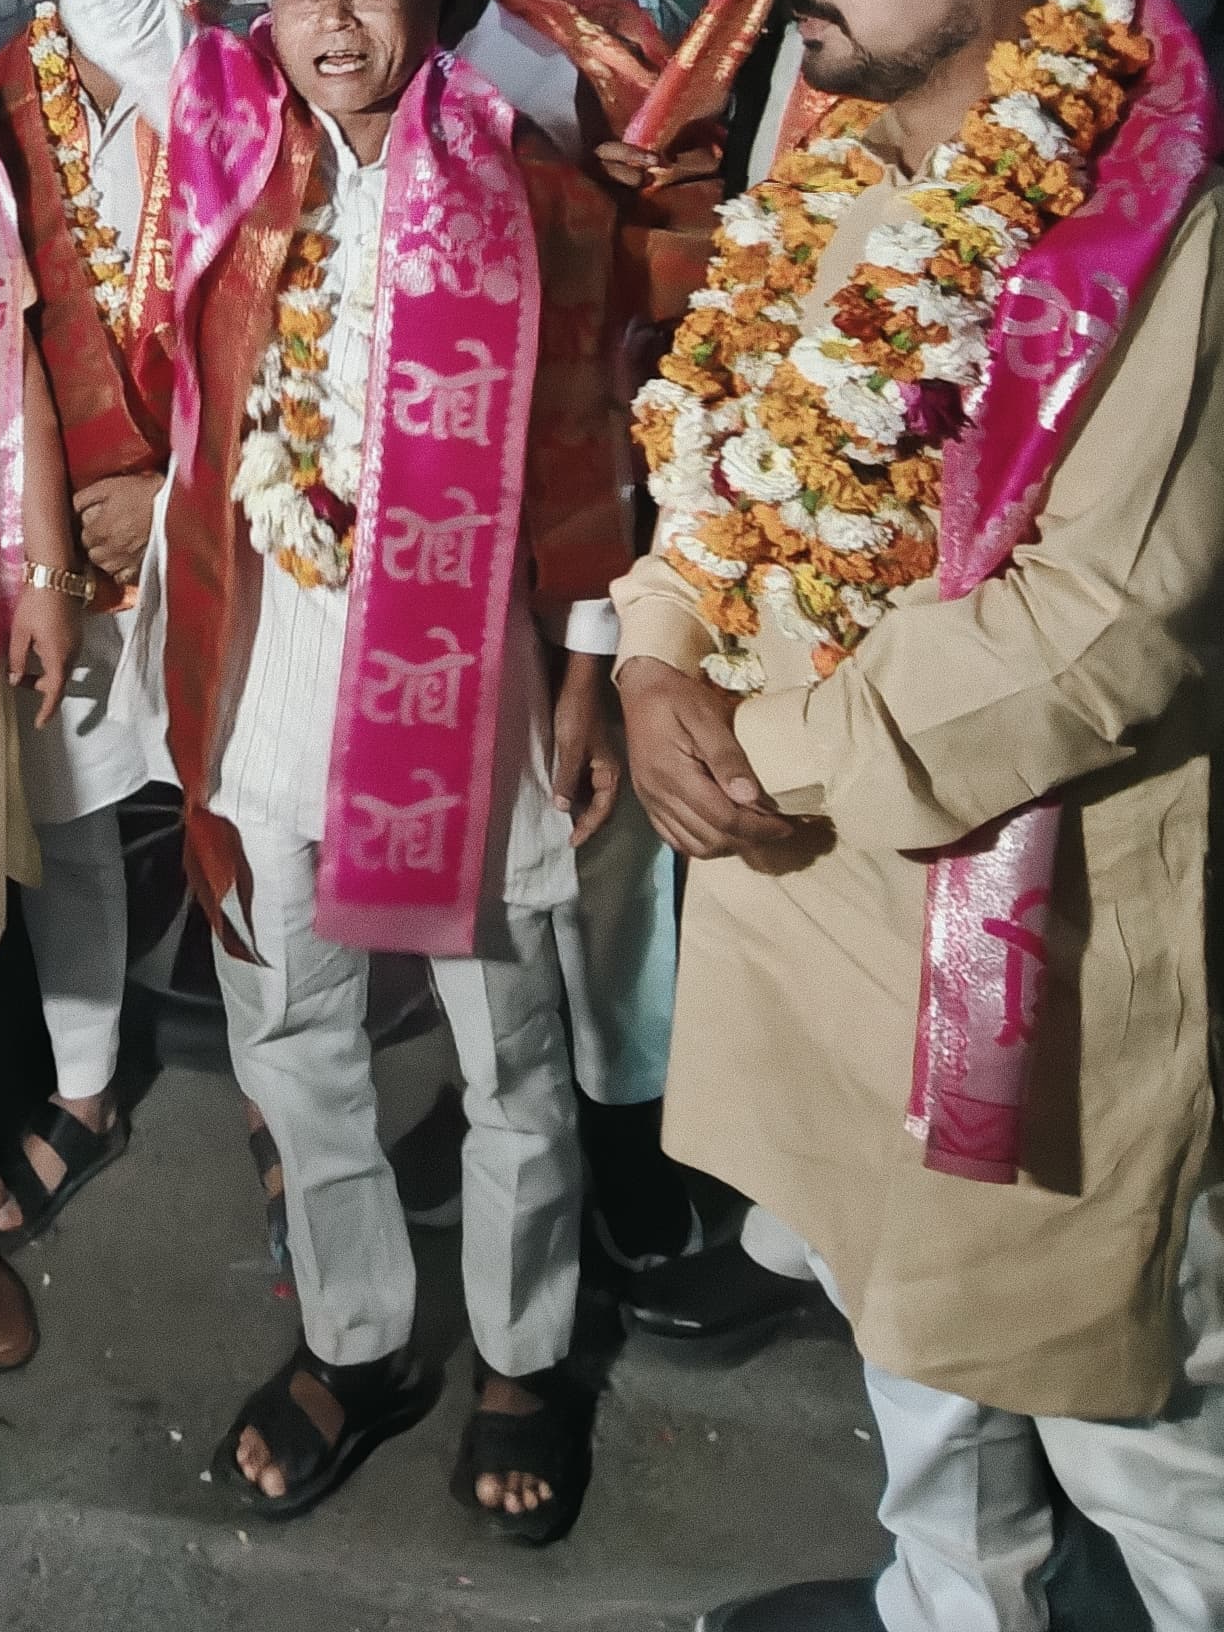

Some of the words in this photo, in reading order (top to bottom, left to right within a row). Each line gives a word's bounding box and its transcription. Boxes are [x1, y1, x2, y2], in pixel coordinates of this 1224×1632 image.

[391, 339, 508, 446] राधे
[380, 488, 495, 590] राधे
[359, 628, 475, 730] राधे
[348, 769, 462, 873] राधे
